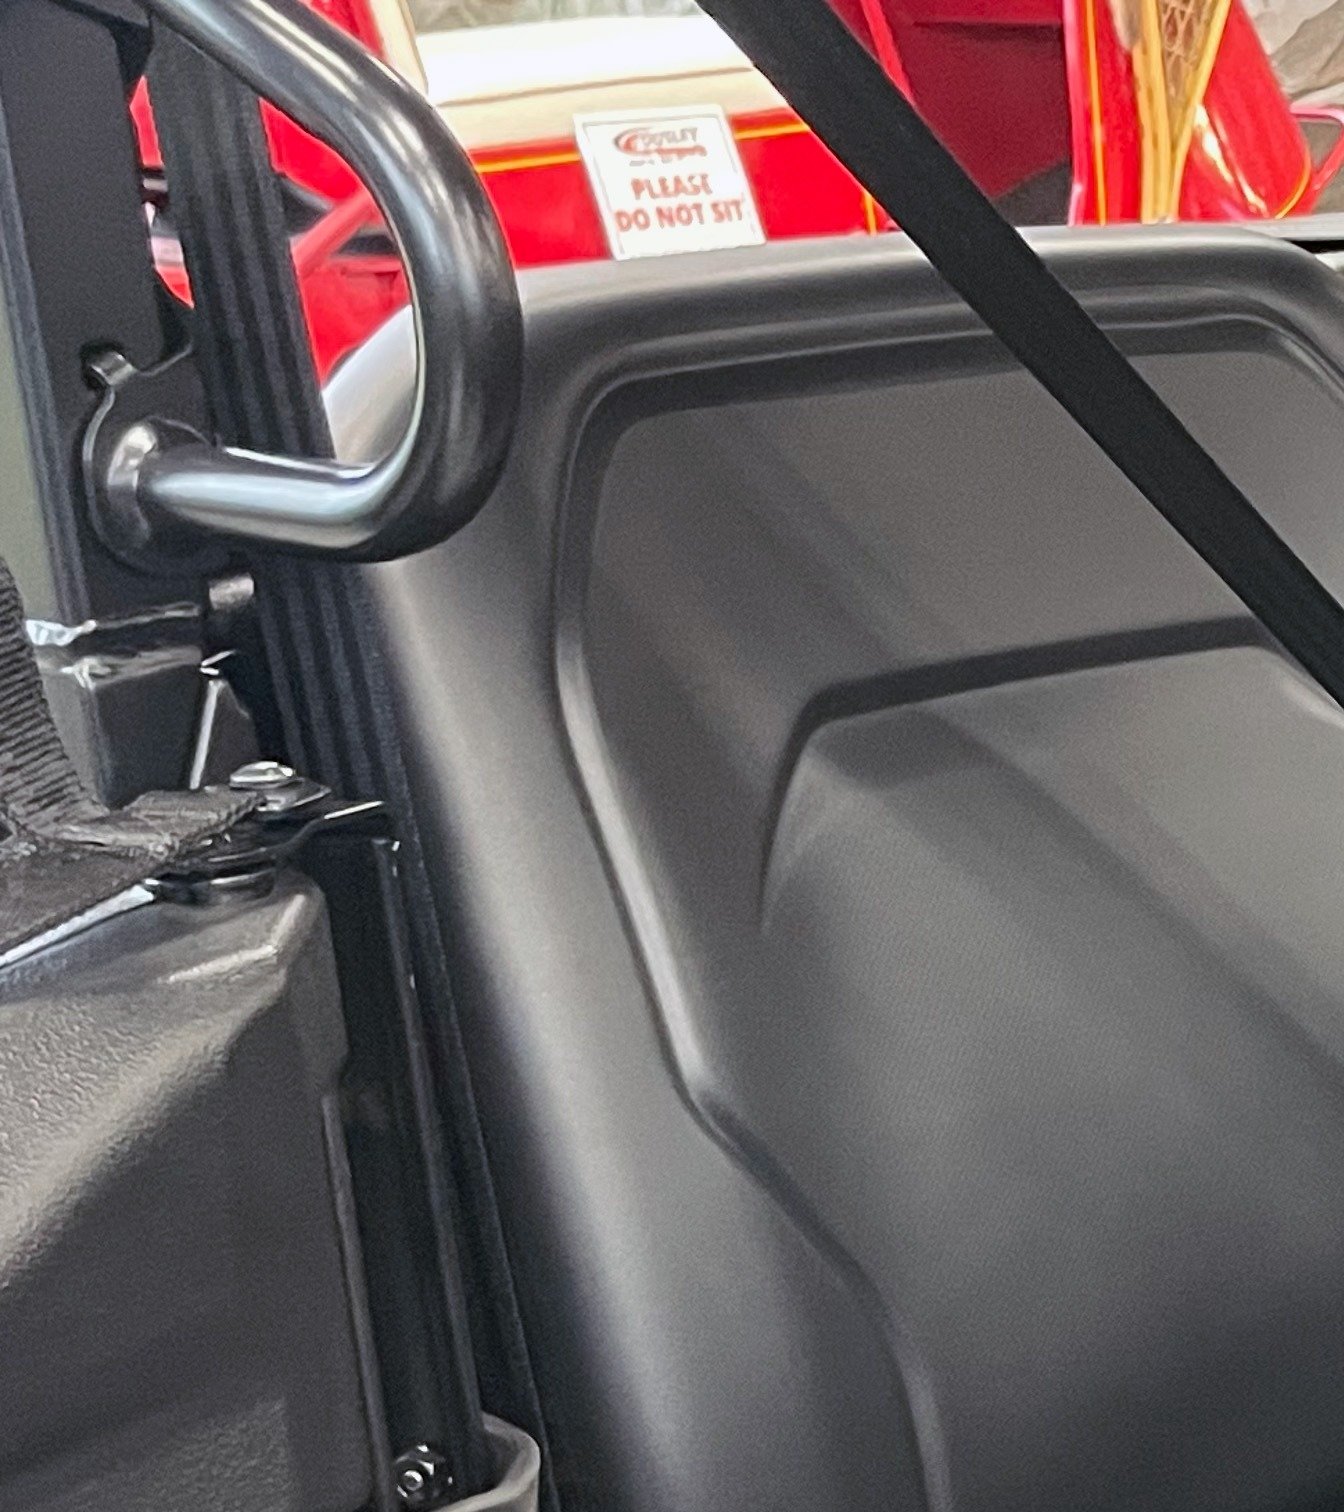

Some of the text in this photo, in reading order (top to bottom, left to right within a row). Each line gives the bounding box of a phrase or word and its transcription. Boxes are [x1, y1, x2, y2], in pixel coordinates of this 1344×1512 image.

[630, 174, 713, 200] PLEASE
[615, 200, 743, 232] DO NOT SIT
